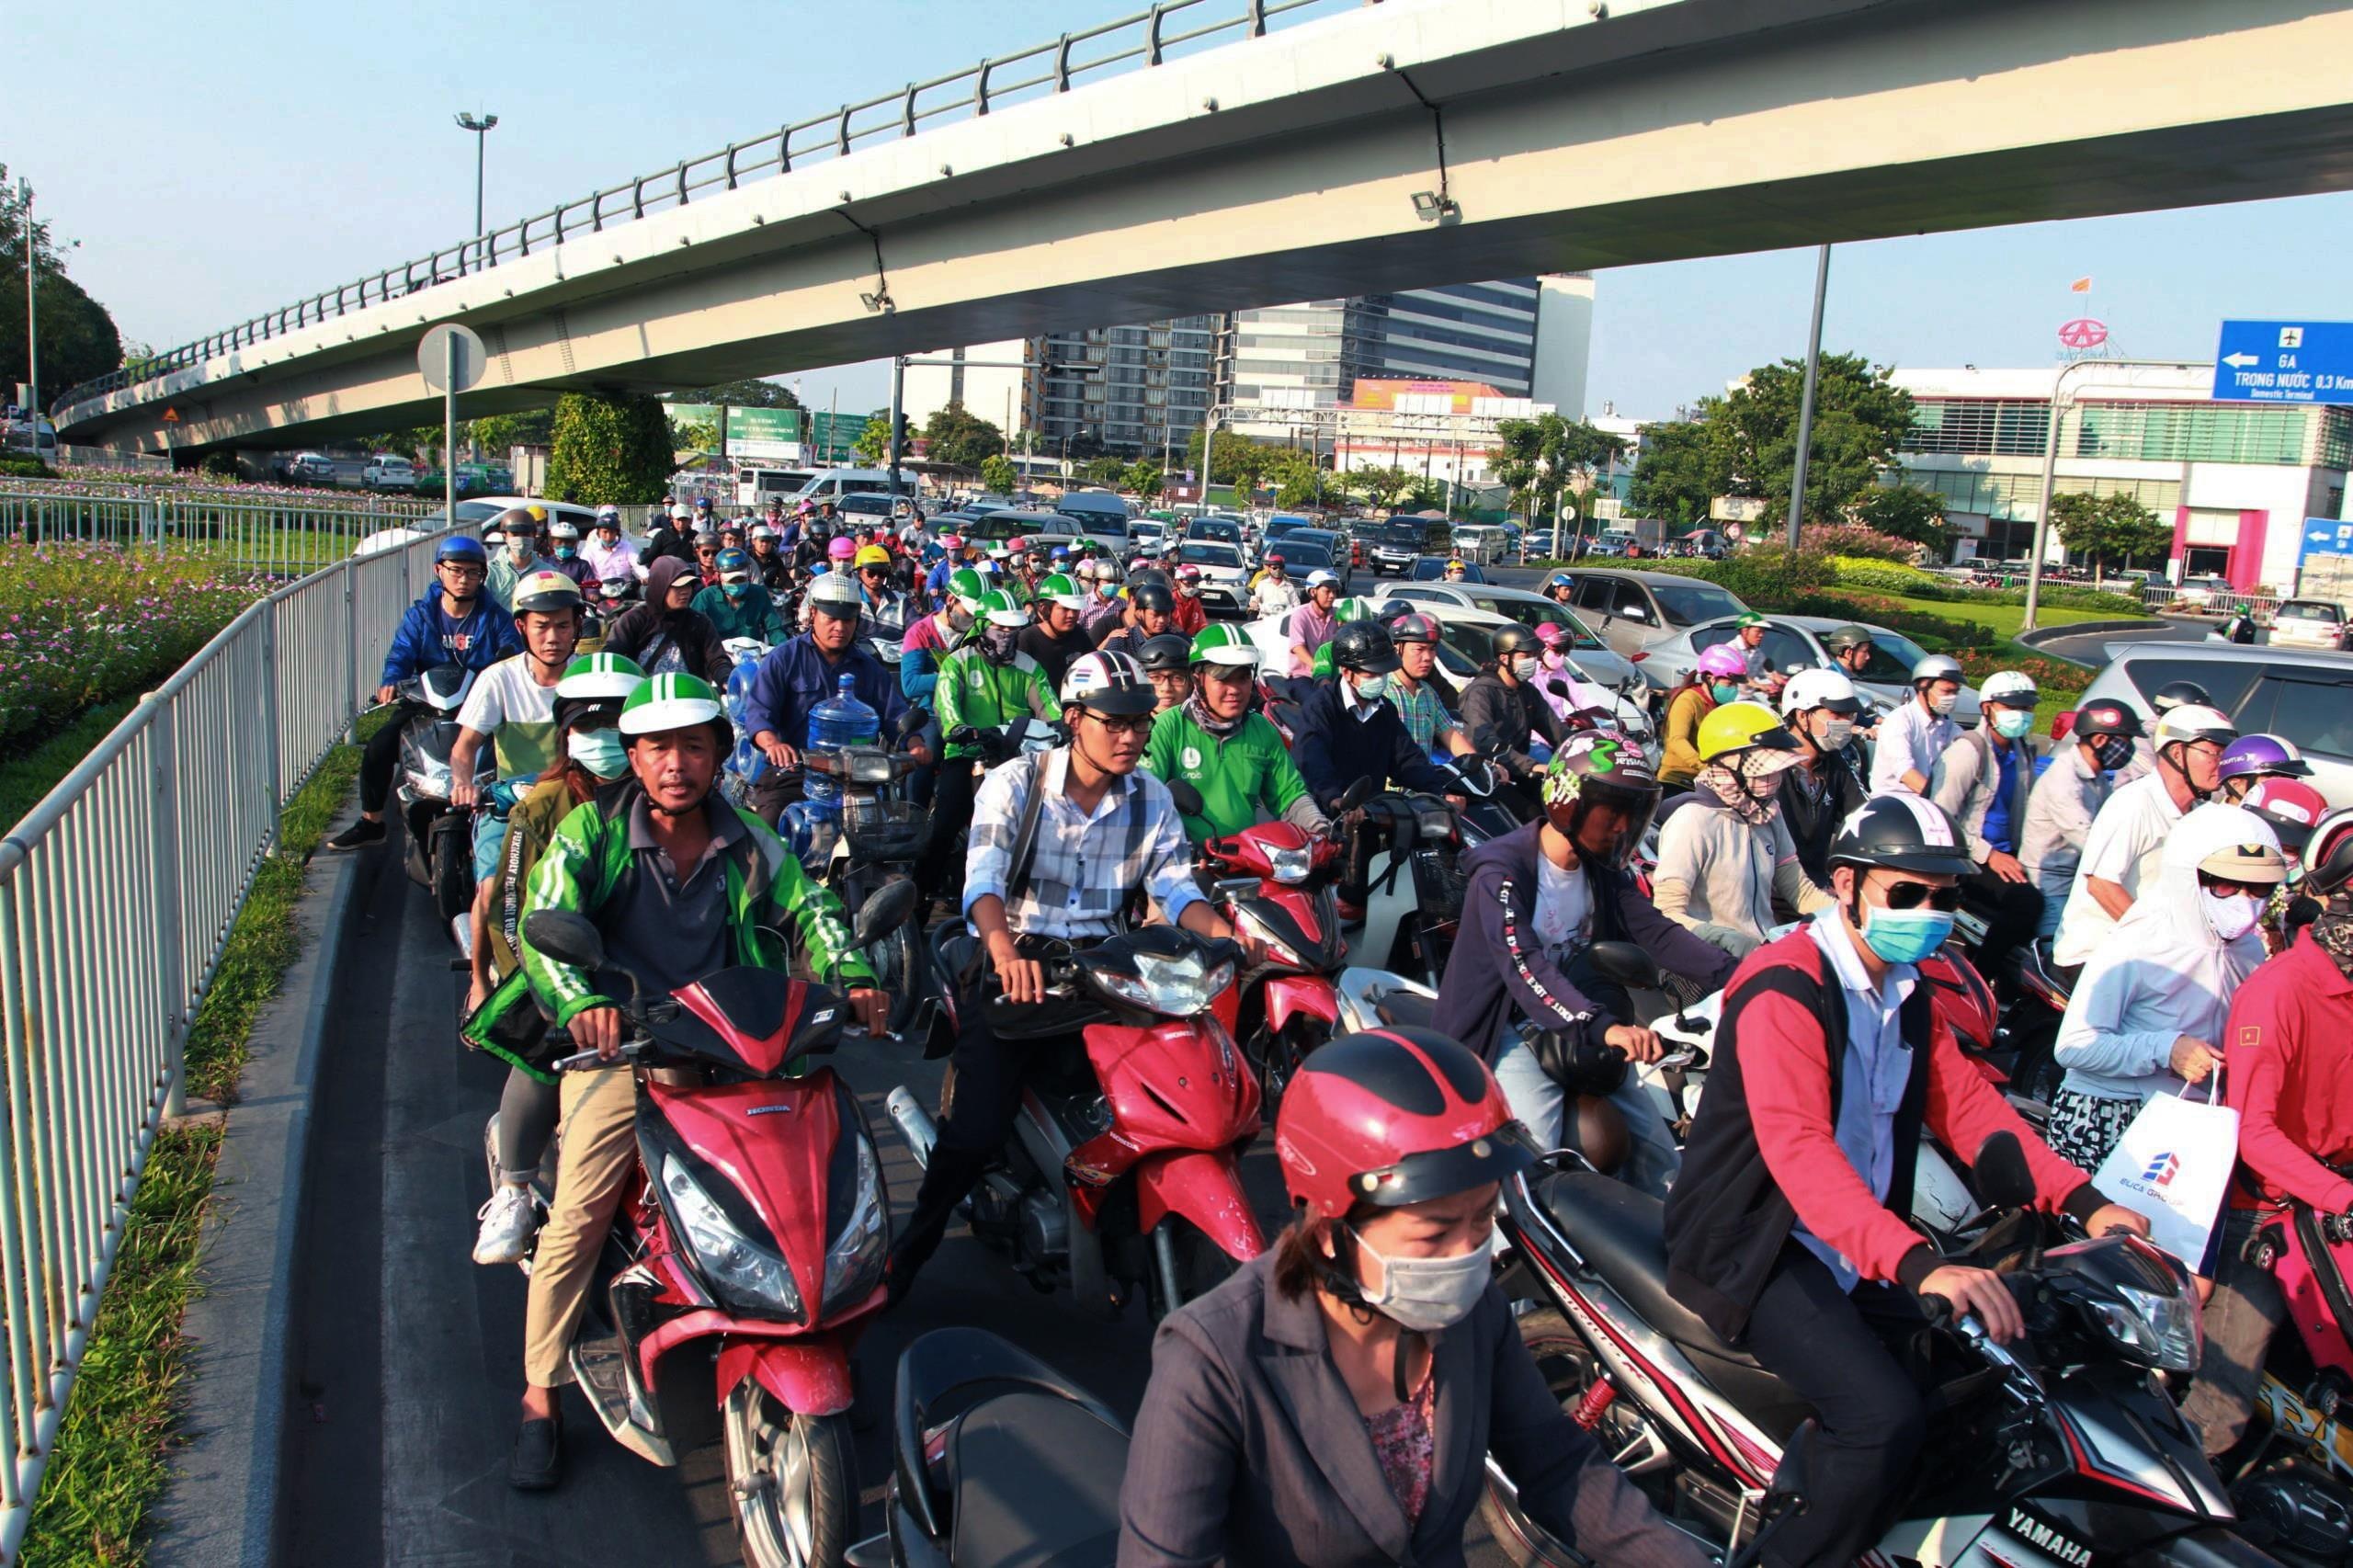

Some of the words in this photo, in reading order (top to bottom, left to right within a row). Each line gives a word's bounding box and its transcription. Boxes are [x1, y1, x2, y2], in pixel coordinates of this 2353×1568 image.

[2278, 354, 2297, 369] GA
[2234, 371, 2274, 387] TRONG
[2276, 369, 2311, 389] NƯỚC
[2250, 388, 2283, 399] Domestic
[2284, 390, 2314, 401] Terminal
[1180, 770, 1203, 780] Grab
[1526, 975, 1548, 999] EXIT
[746, 1104, 791, 1116] HONDA
[1108, 1131, 1136, 1150] HONDA
[2007, 1506, 2094, 1568] YAMAHA
